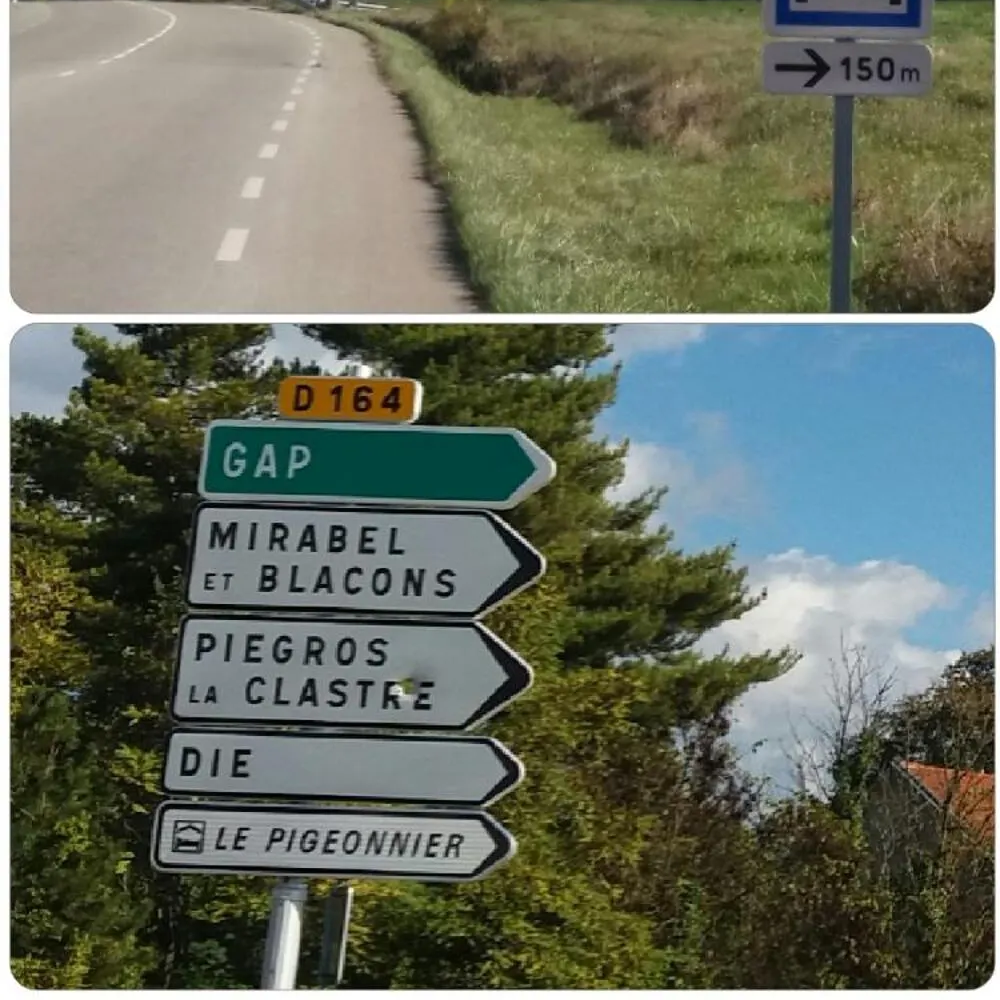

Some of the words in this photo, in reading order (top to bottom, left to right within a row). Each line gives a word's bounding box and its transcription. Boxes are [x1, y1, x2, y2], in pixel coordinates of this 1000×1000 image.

[292, 384, 315, 413] D
[329, 385, 402, 414] 164
[222, 441, 312, 479] GAP
[208, 521, 406, 556] MIRABEL
[203, 572, 234, 592] ET
[258, 564, 457, 598] BLACONS
[195, 632, 390, 667] PIEGROS
[189, 684, 218, 704] LA
[244, 677, 435, 712] CLASTRE
[179, 747, 252, 779] DIE
[214, 827, 250, 851] LE
[265, 828, 465, 858] PIGEONNIER
